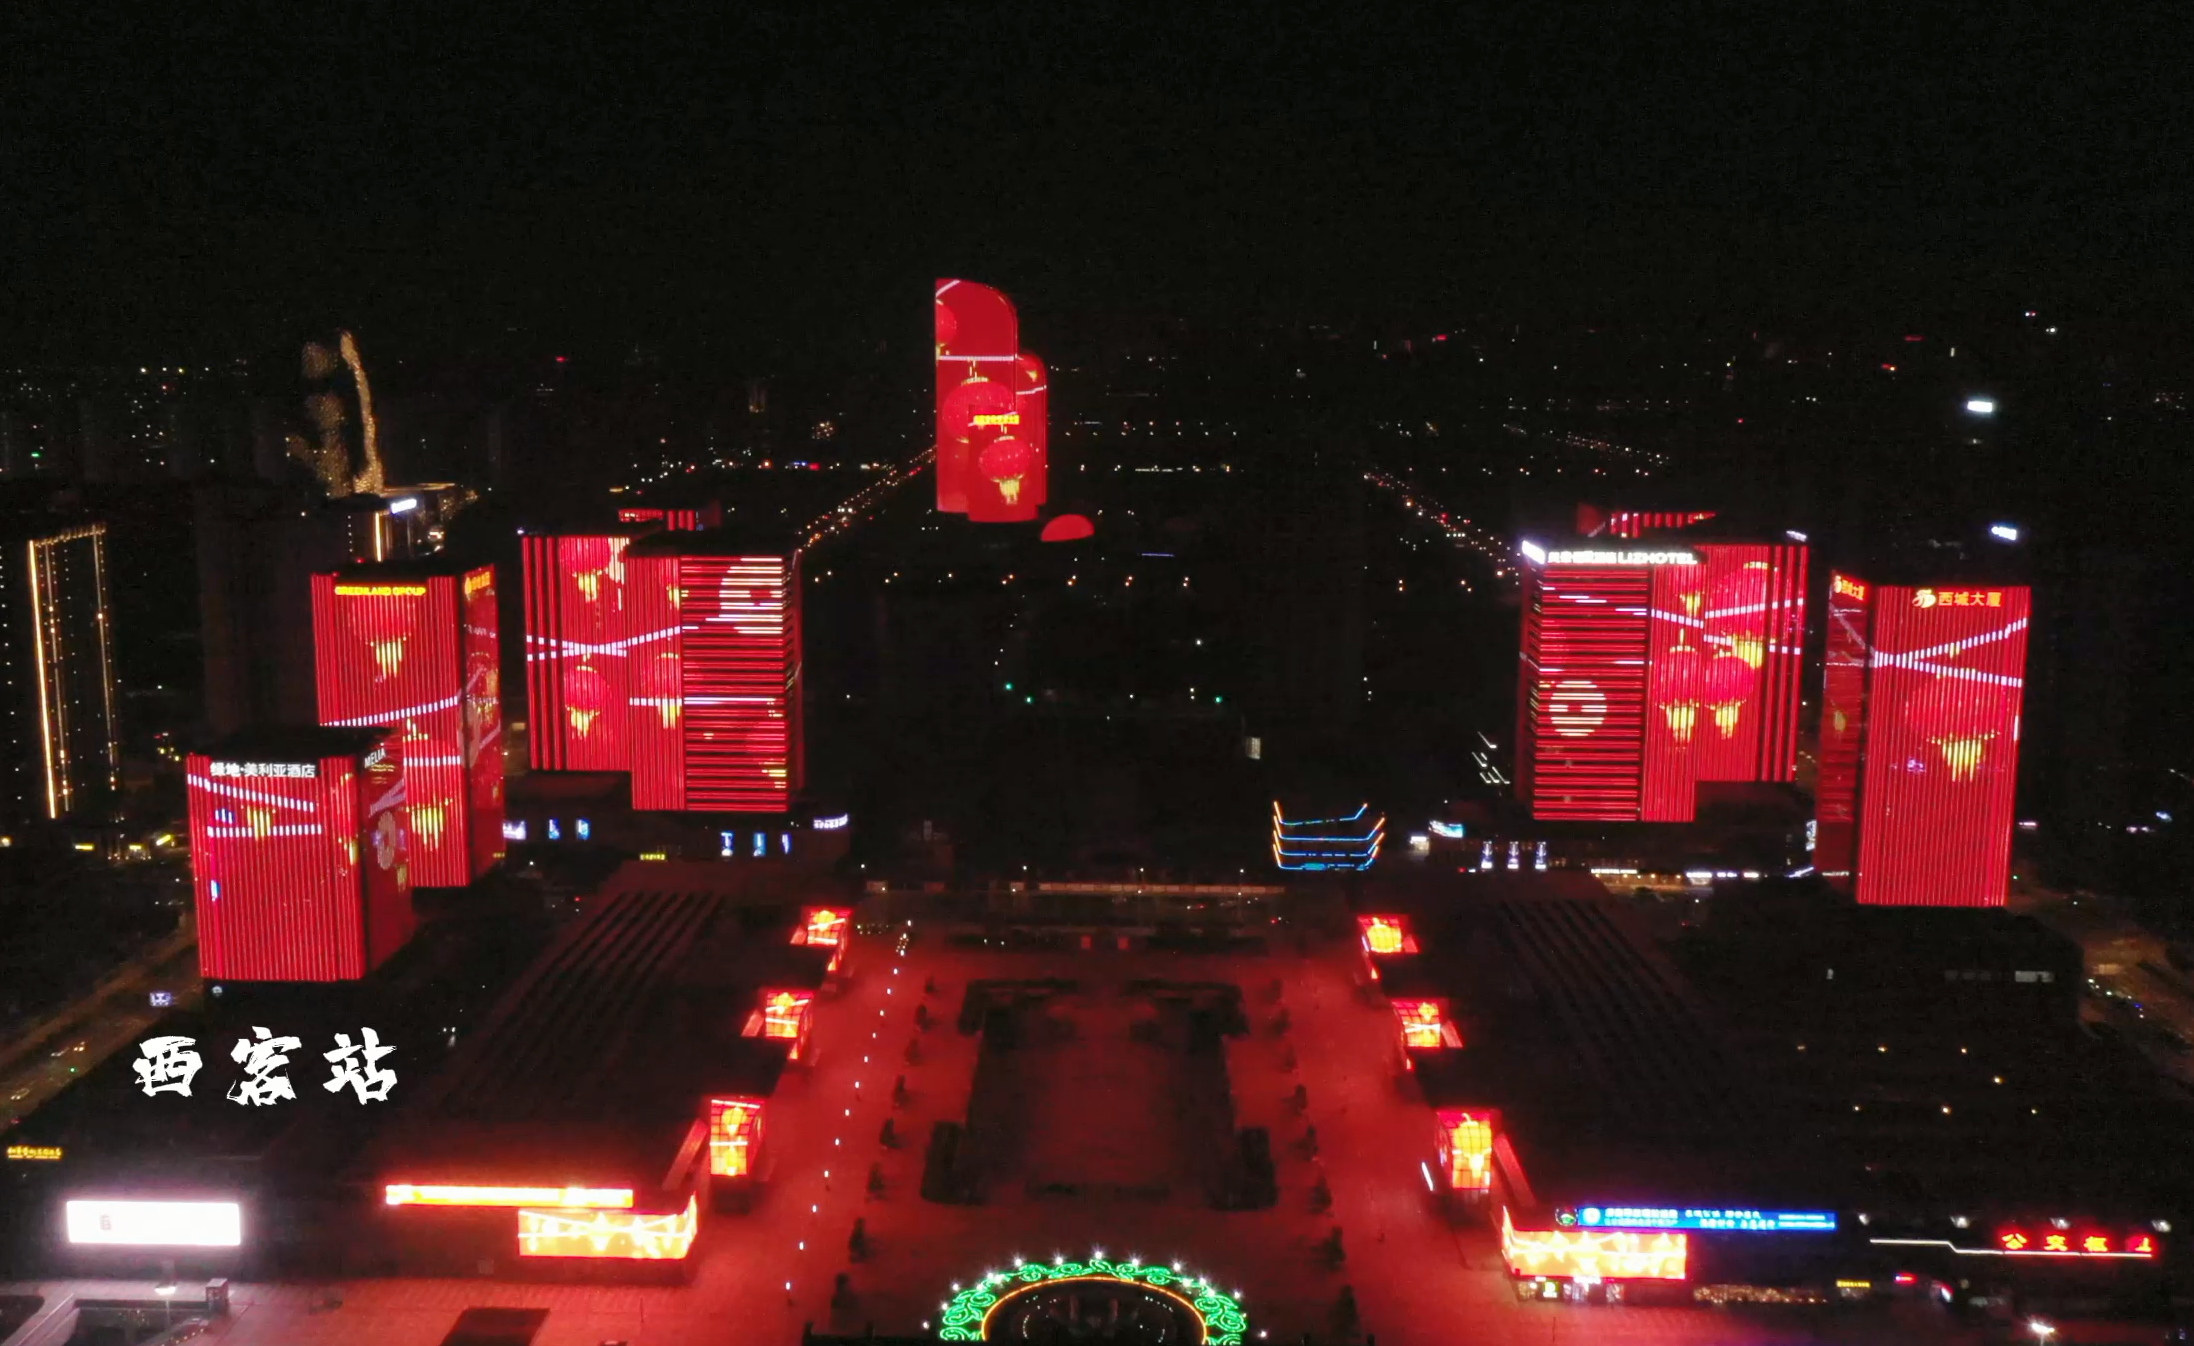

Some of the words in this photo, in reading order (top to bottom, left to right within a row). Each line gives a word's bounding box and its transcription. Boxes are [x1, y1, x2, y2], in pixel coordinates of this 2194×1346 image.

[334, 586, 392, 596] GREENLAND
[392, 586, 426, 596] GROUP
[1938, 591, 2001, 607] 西城大厦
